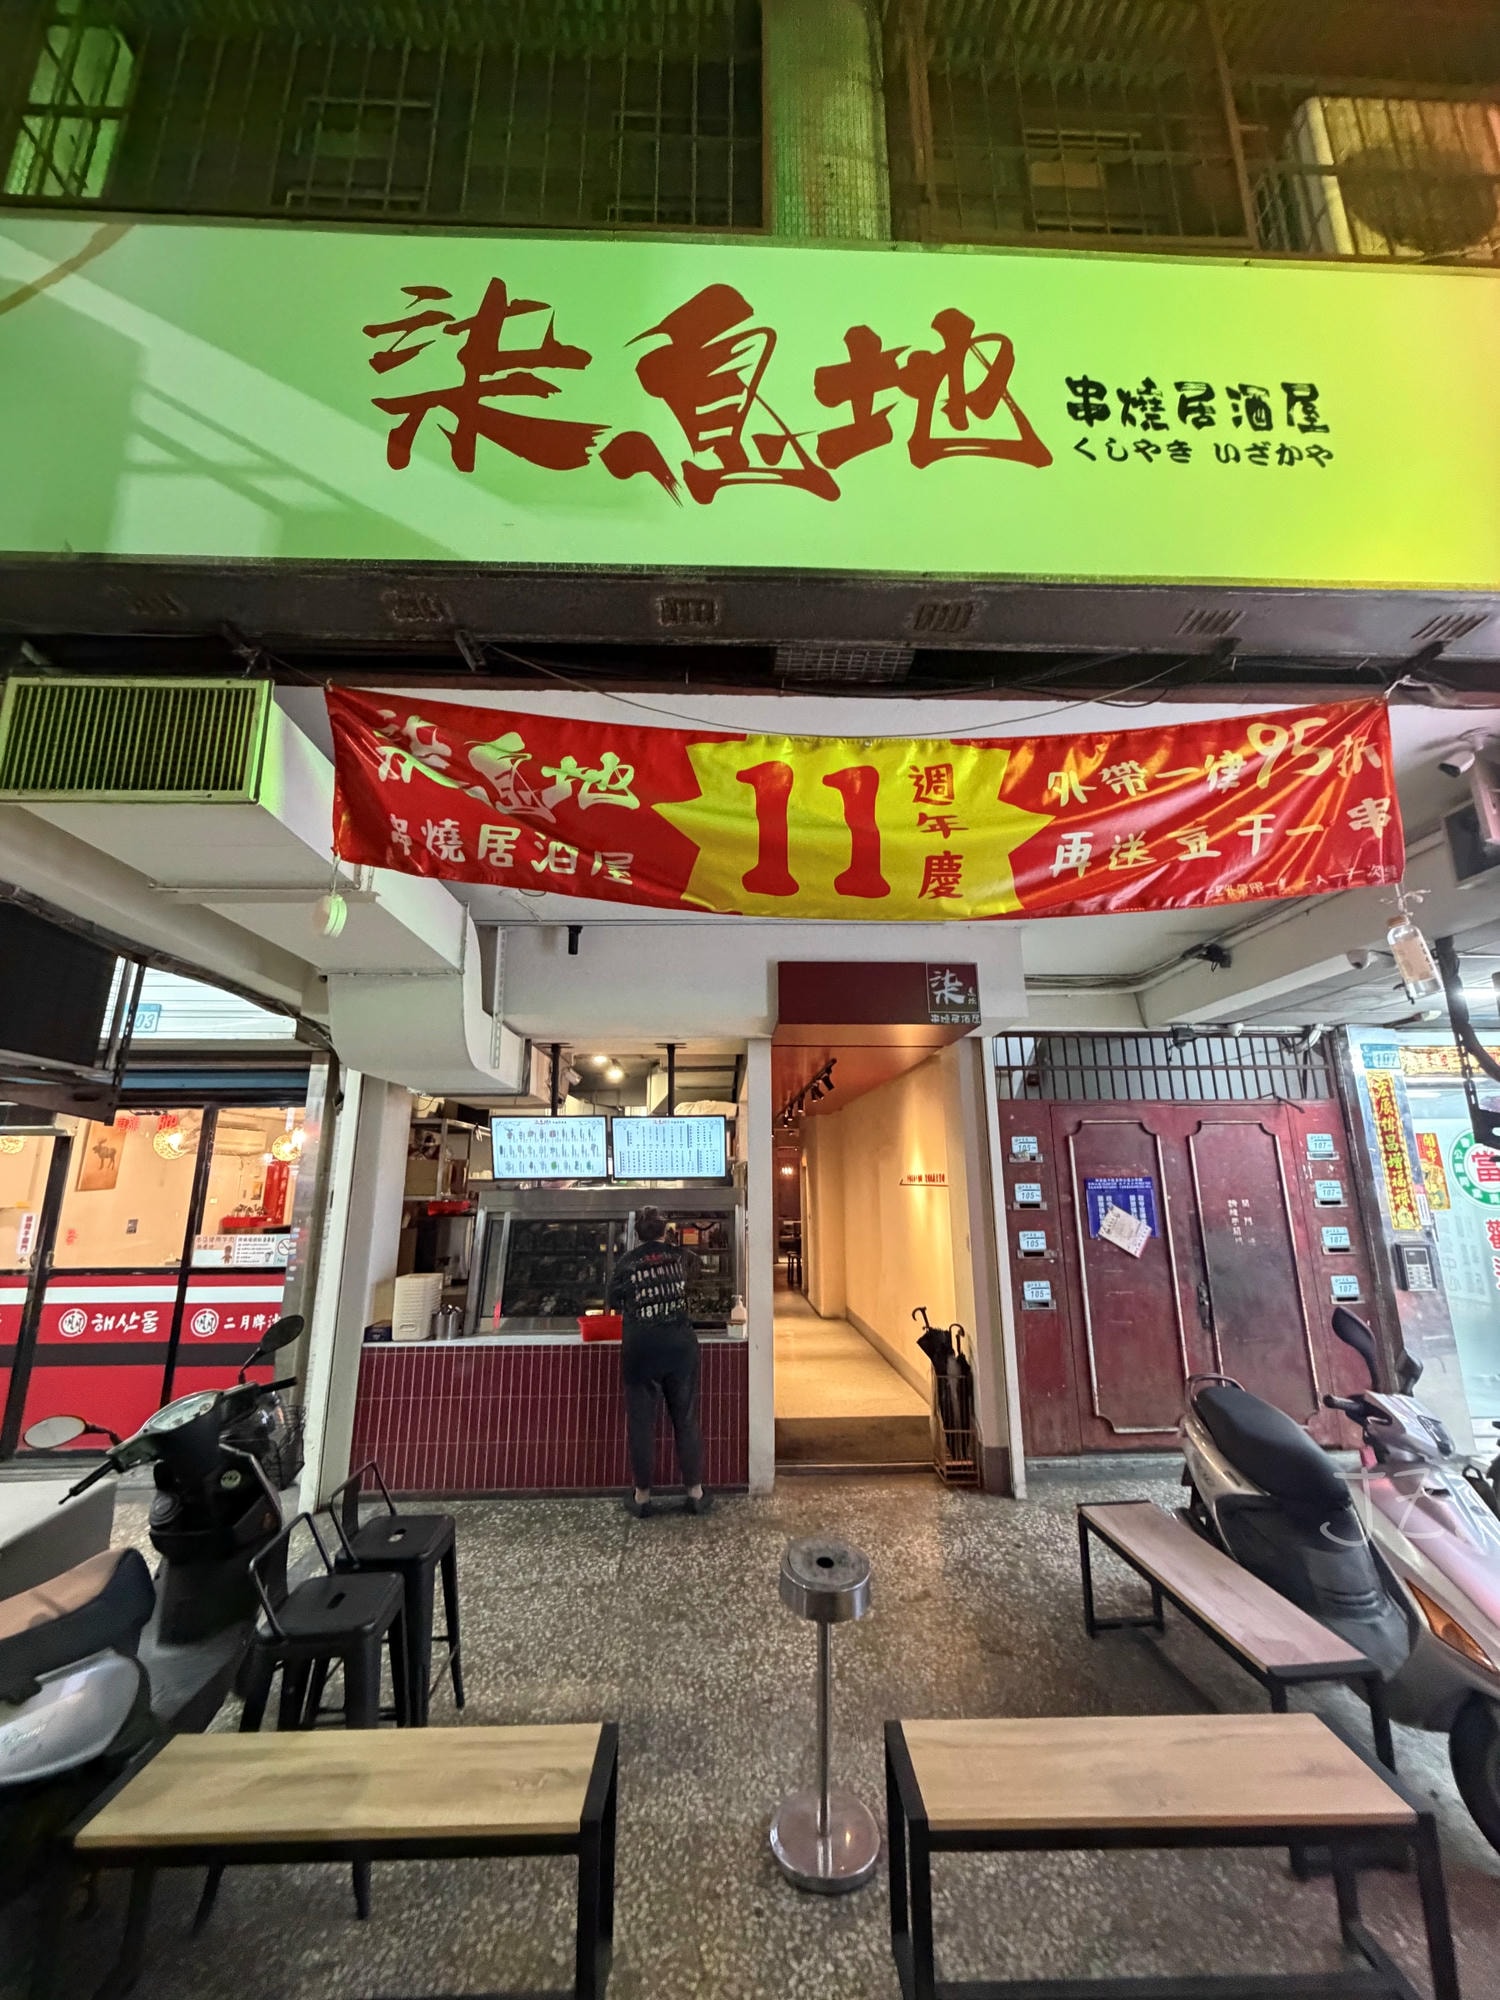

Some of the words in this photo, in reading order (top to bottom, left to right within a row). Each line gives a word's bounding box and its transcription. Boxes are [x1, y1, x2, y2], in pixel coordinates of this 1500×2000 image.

[1065, 374, 1330, 433] 串燒居酒屋
[1074, 438, 1193, 464] くしやき
[1213, 441, 1334, 468] いざかや
[390, 813, 634, 886] 串燒居酒屋
[735, 760, 891, 899] 11
[908, 763, 969, 899] 週年慶
[91, 1310, 159, 1333] 해산물
